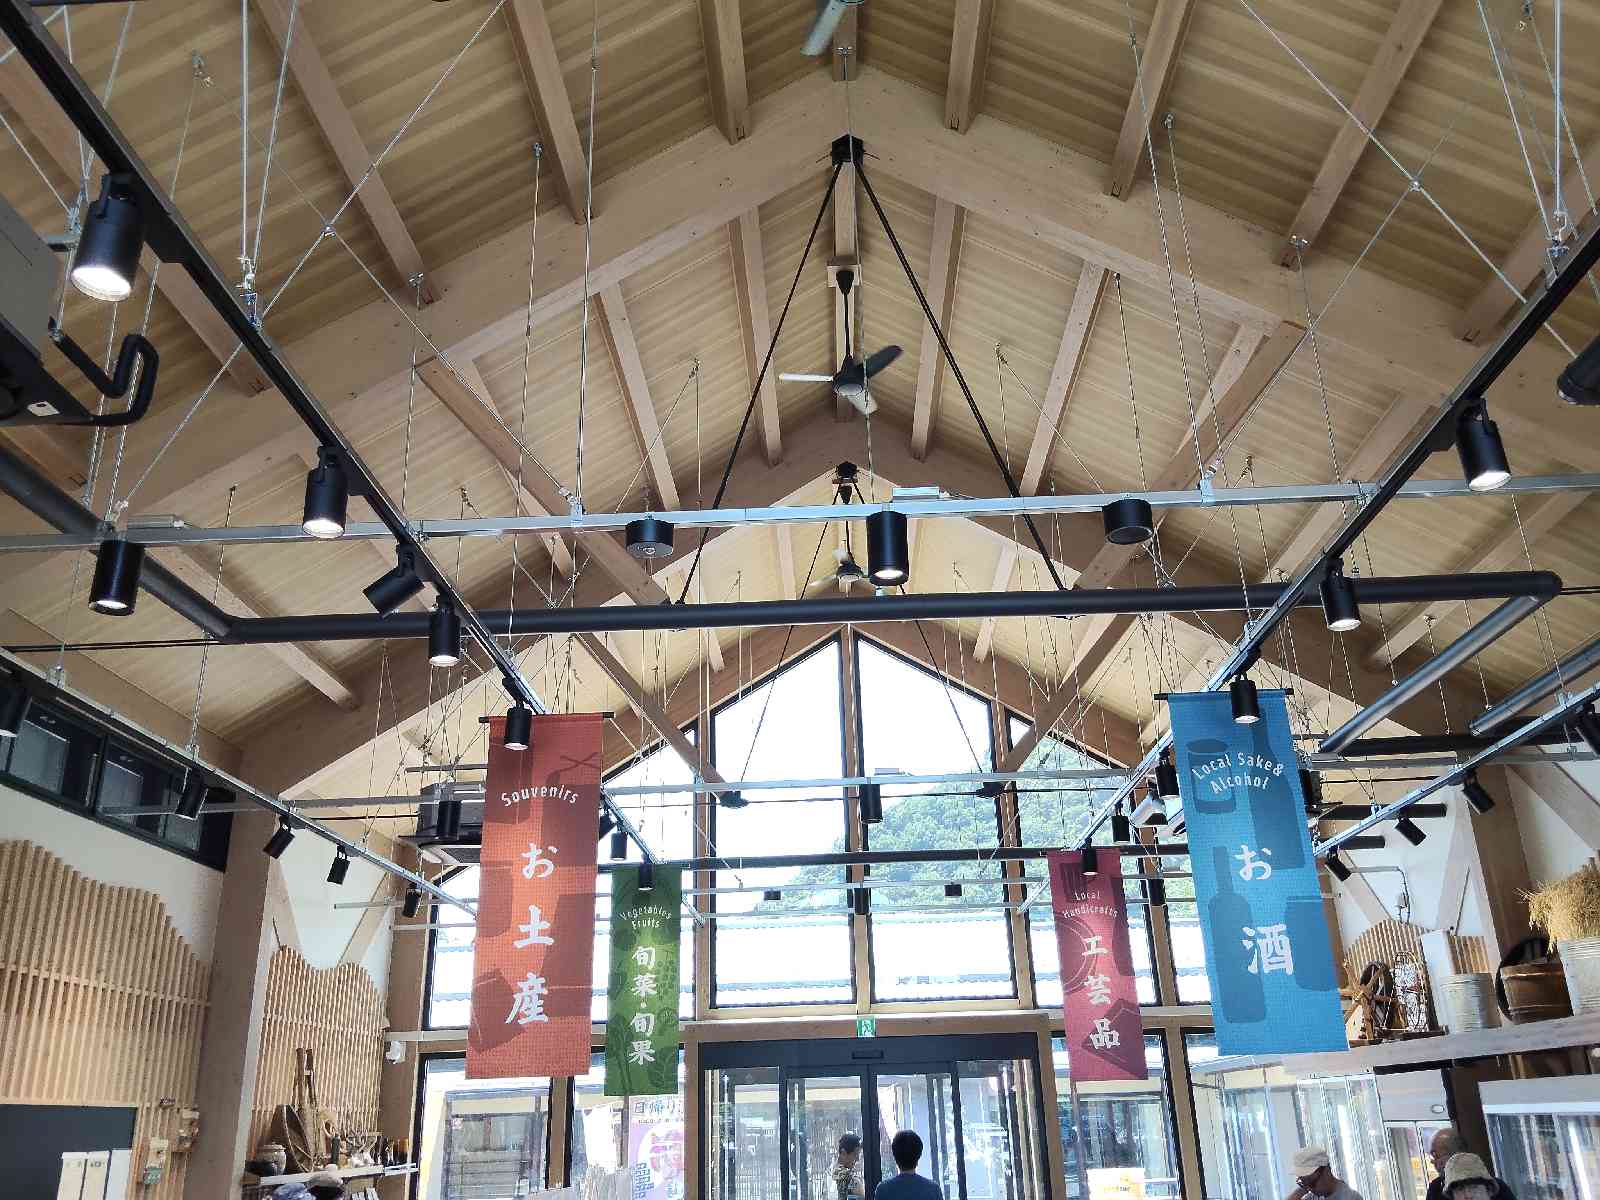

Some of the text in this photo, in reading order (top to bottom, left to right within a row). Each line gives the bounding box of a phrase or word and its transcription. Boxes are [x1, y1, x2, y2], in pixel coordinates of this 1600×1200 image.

[1191, 753, 1232, 780] Local
[1210, 771, 1269, 794] Alcohol
[501, 784, 579, 807] Souvenirs
[1074, 890, 1100, 901] Local
[619, 904, 672, 921] Vegetables
[1062, 904, 1119, 919] Handicrafts
[1233, 844, 1295, 975] お酒
[505, 842, 559, 1025] お土産
[631, 917, 660, 930] Fruits
[1082, 935, 1121, 1050] 工芸品
